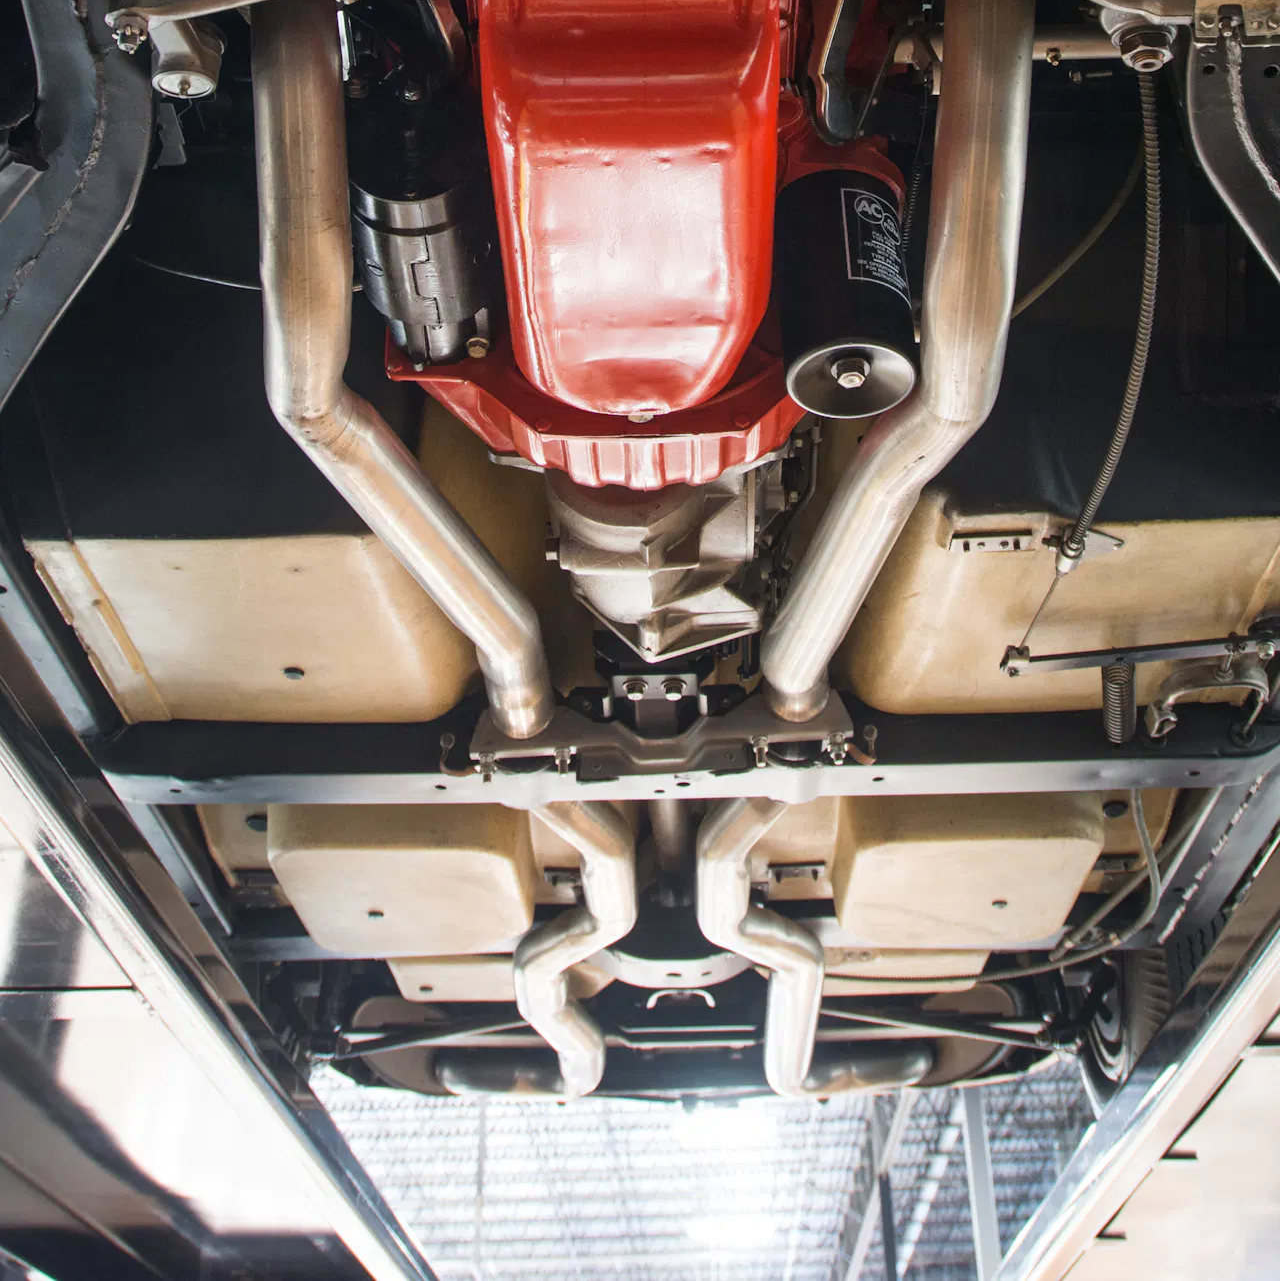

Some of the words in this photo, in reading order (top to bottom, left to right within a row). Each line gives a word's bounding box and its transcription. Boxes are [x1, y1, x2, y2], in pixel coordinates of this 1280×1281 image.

[858, 199, 882, 219] AC
[883, 221, 899, 239] FILTER
[870, 252, 885, 261] TYPE
